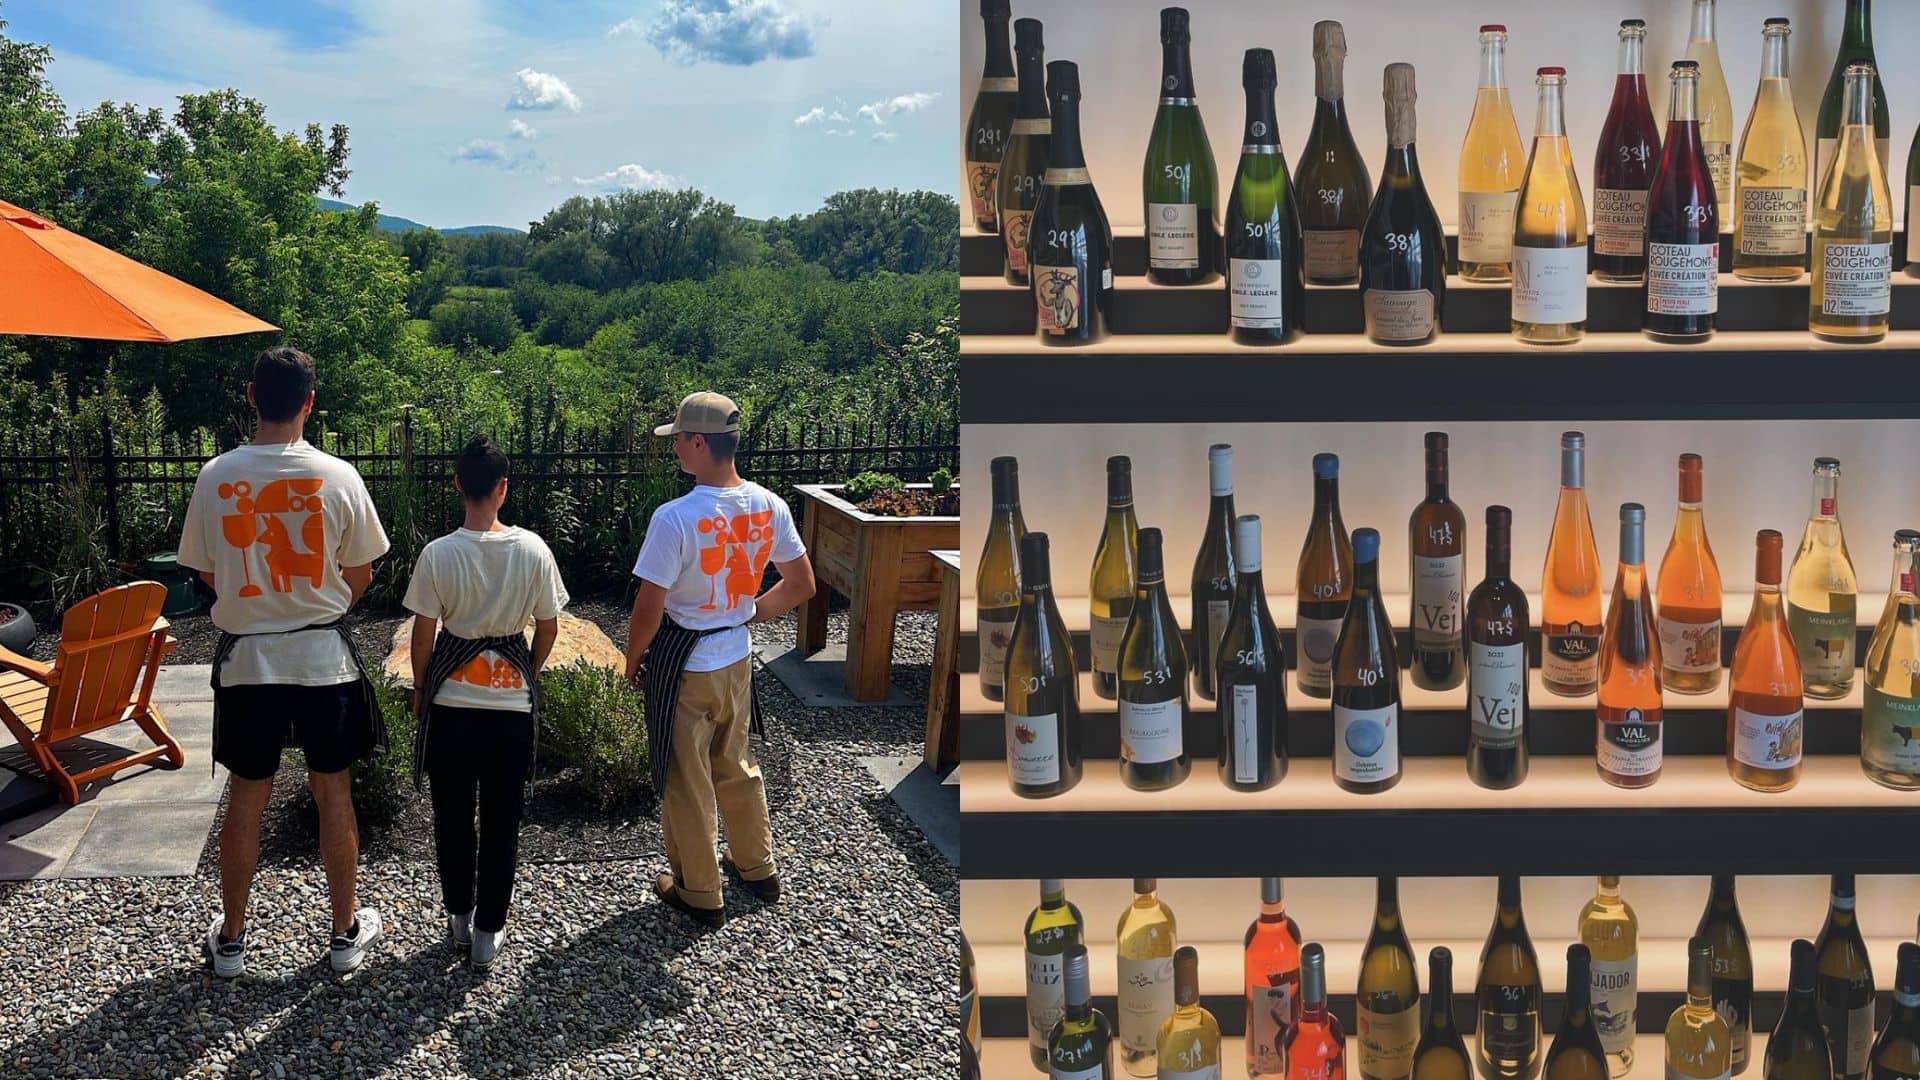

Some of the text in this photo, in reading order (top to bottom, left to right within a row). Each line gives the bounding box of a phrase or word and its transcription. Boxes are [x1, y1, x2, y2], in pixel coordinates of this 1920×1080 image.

[1744, 190, 1784, 201] COTEAU
[1651, 245, 1691, 257] COTEAU
[1825, 246, 1871, 257] COTEAU
[1650, 256, 1712, 268] ROUGEMONT
[1825, 256, 1889, 268] ROUGEMONT
[1824, 299, 1837, 313] 02
[1563, 640, 1587, 650] VAL
[1477, 696, 1517, 734] Vej
[1621, 727, 1647, 739] VAL
